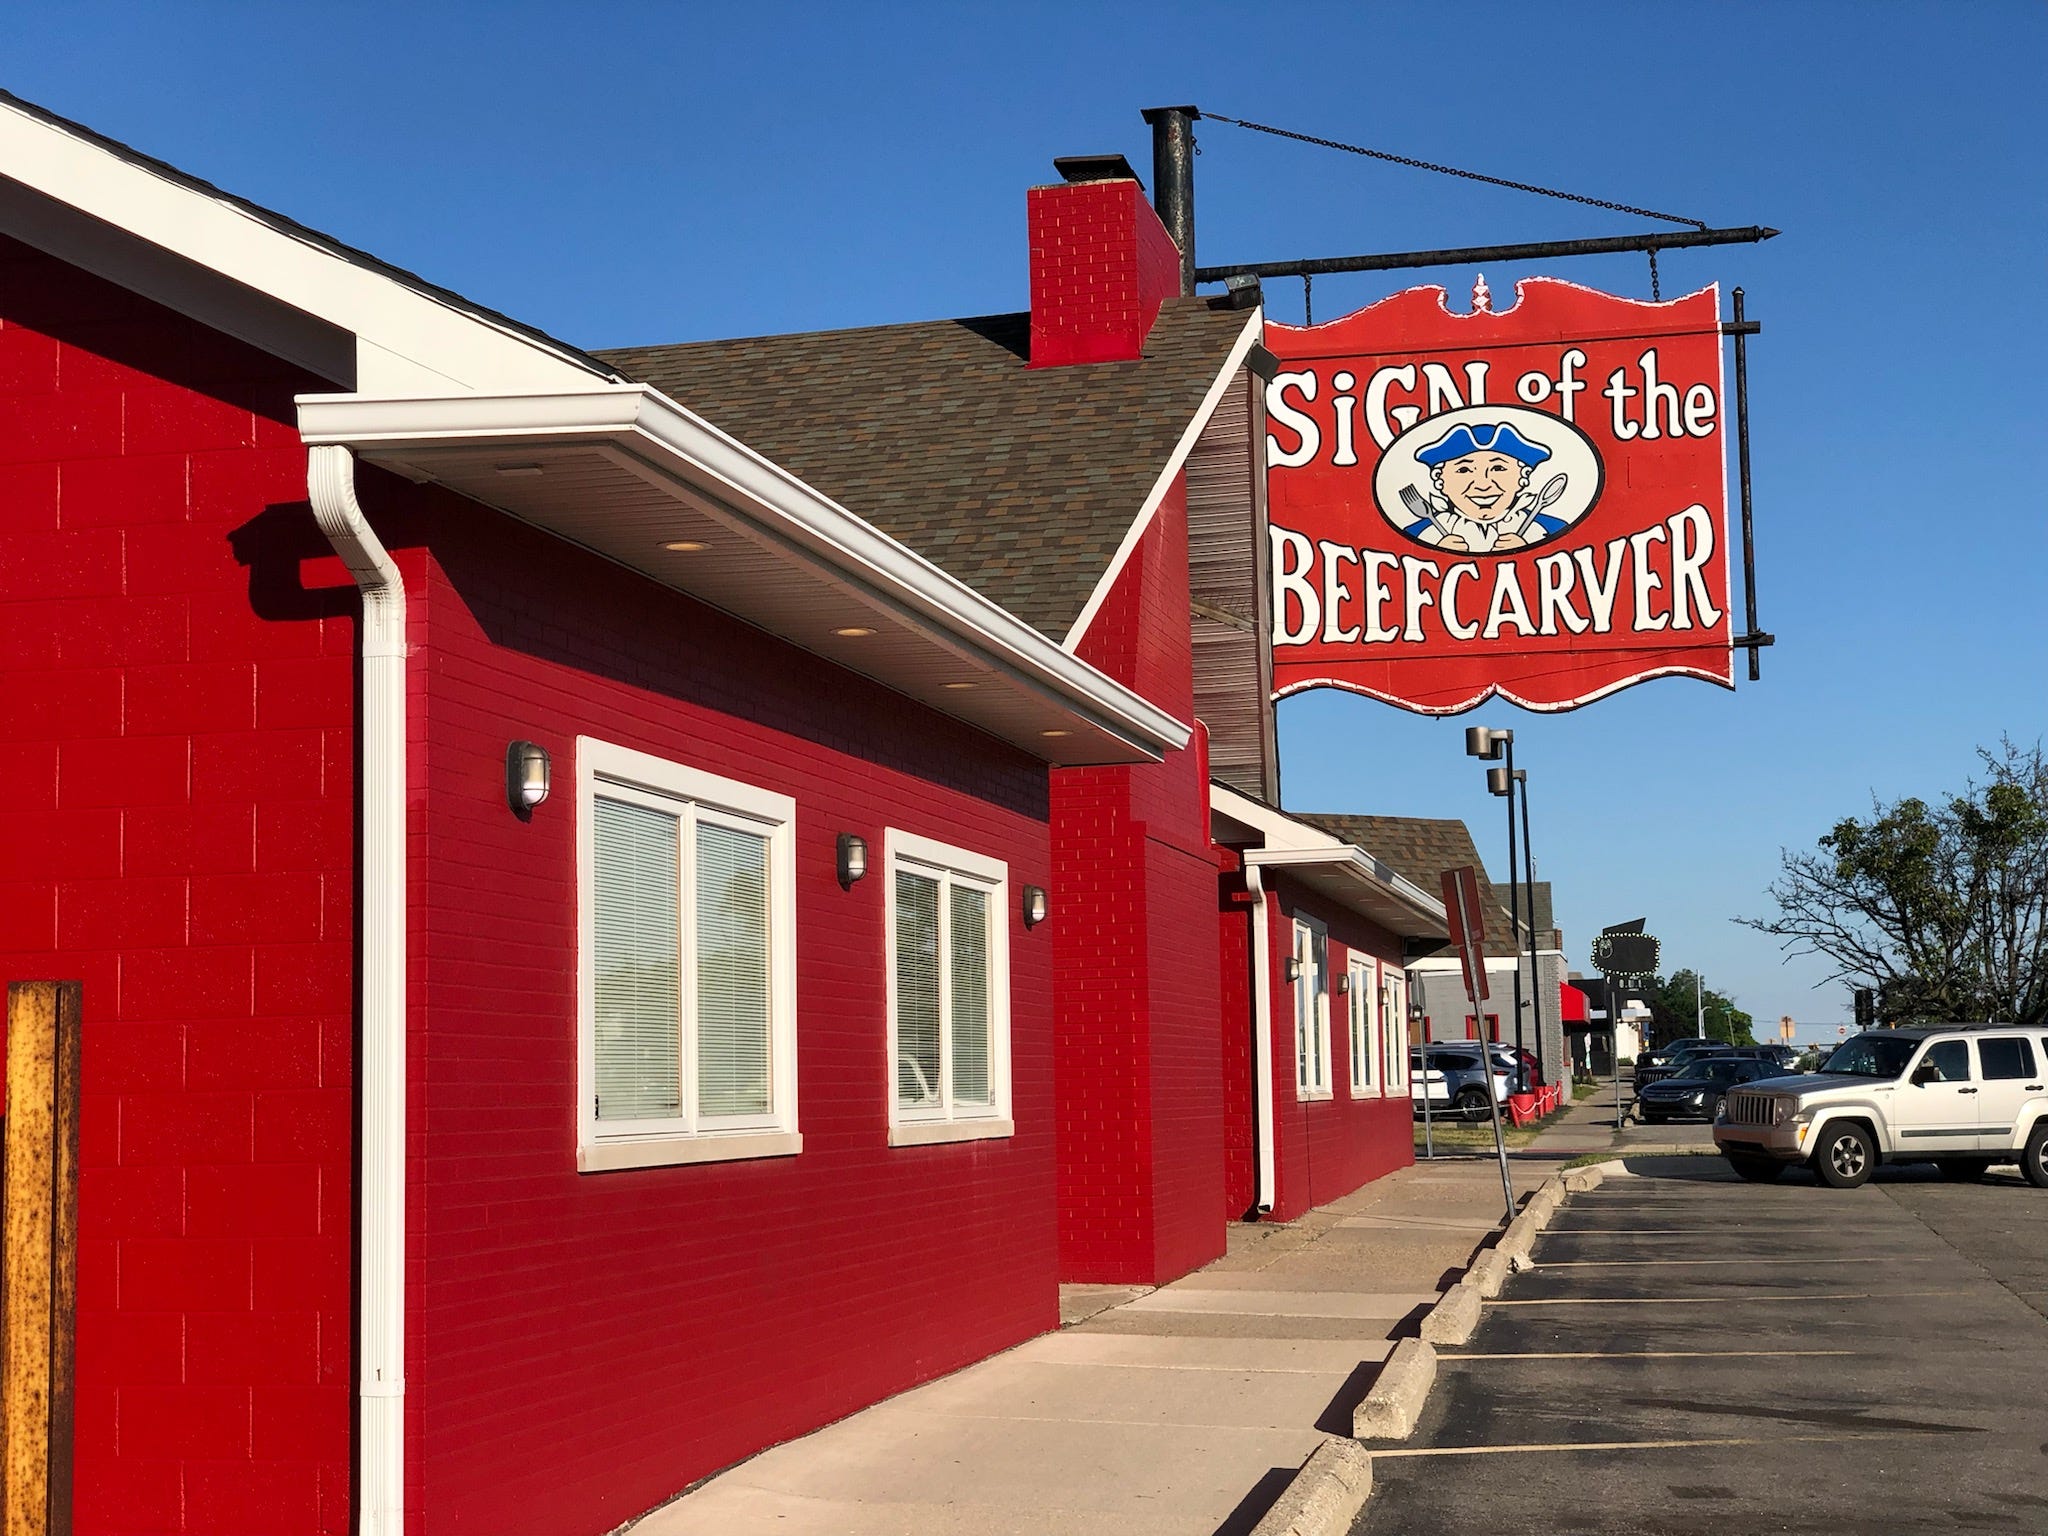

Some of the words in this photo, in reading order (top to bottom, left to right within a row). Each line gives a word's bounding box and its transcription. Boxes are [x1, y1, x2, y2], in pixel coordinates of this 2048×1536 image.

[1516, 348, 1587, 423] of
[1602, 348, 1717, 441] the
[1269, 503, 1723, 646] BEEFCARVER
